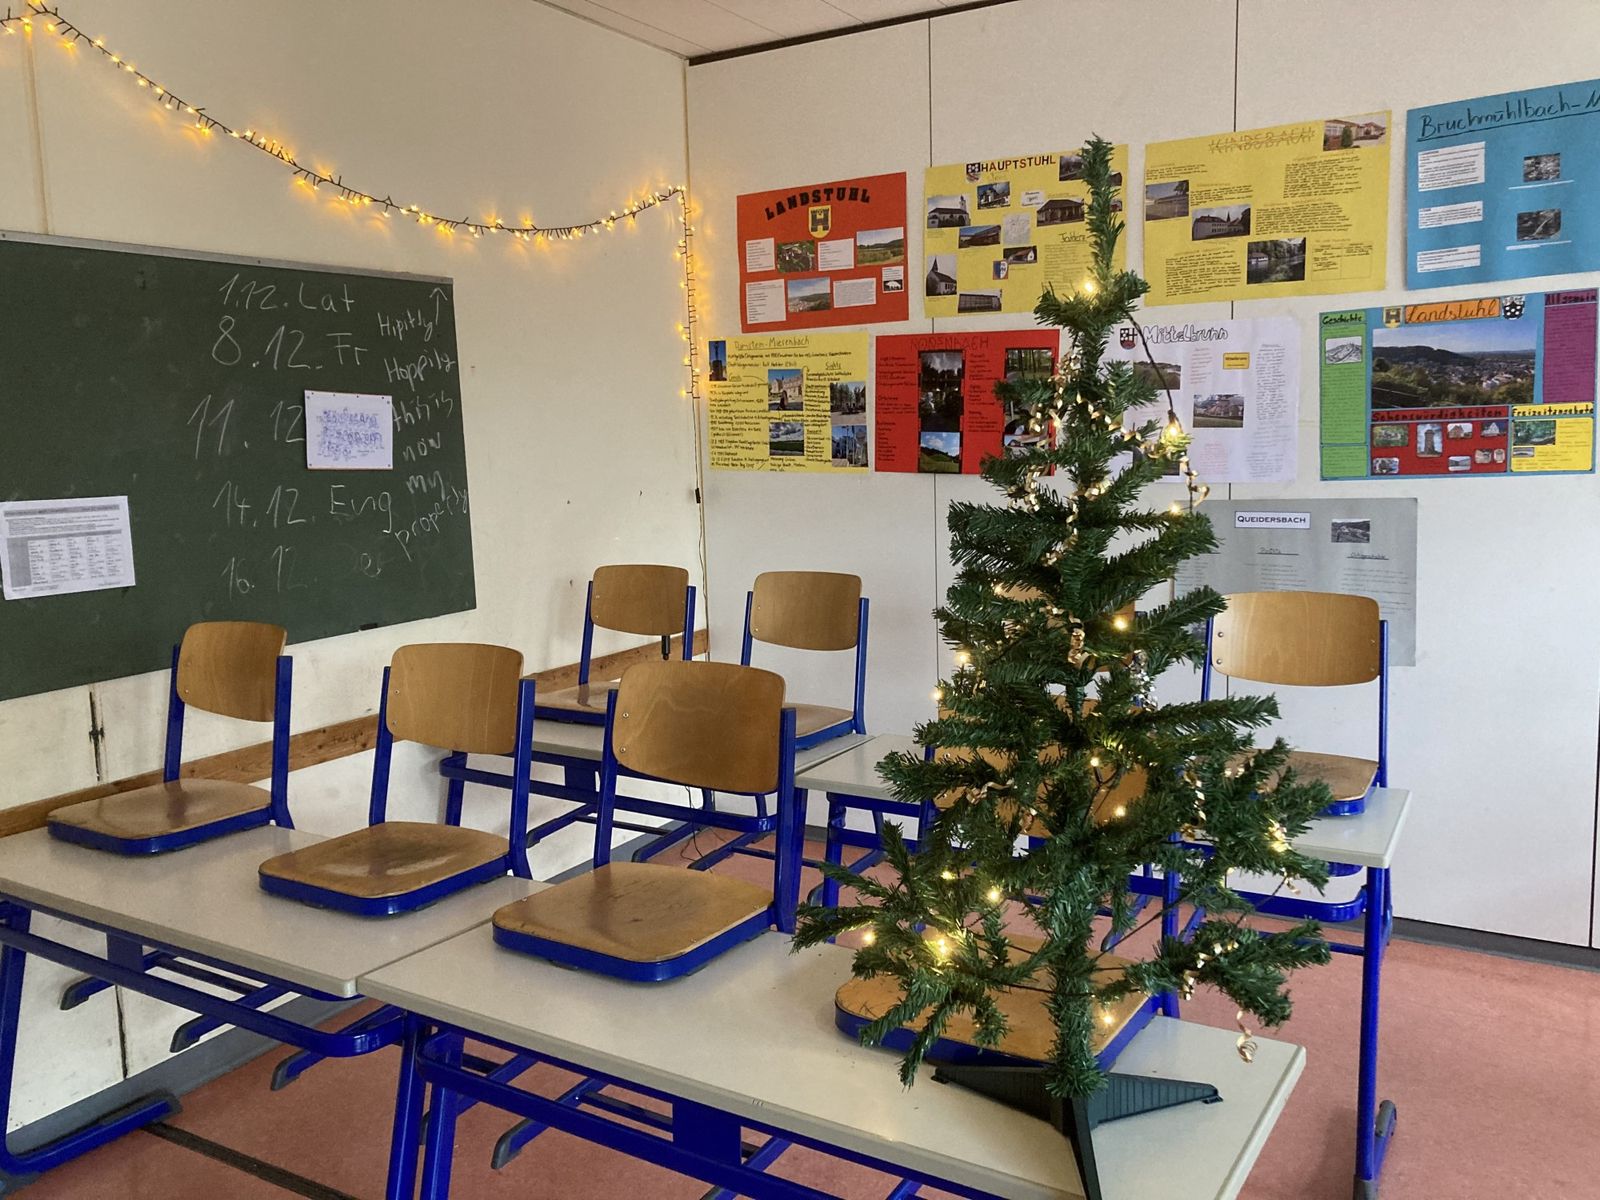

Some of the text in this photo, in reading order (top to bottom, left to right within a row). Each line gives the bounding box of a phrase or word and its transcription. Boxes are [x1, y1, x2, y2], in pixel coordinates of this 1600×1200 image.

[981, 155, 1056, 172] HAUPTSTUHL
[765, 187, 870, 221] LANDSTUHL
[300, 282, 354, 312] Lat
[1407, 299, 1496, 322] Landstuhl
[326, 332, 368, 365] Fr
[1143, 324, 1228, 344] Mittelbrunn
[330, 485, 391, 534] Eng
